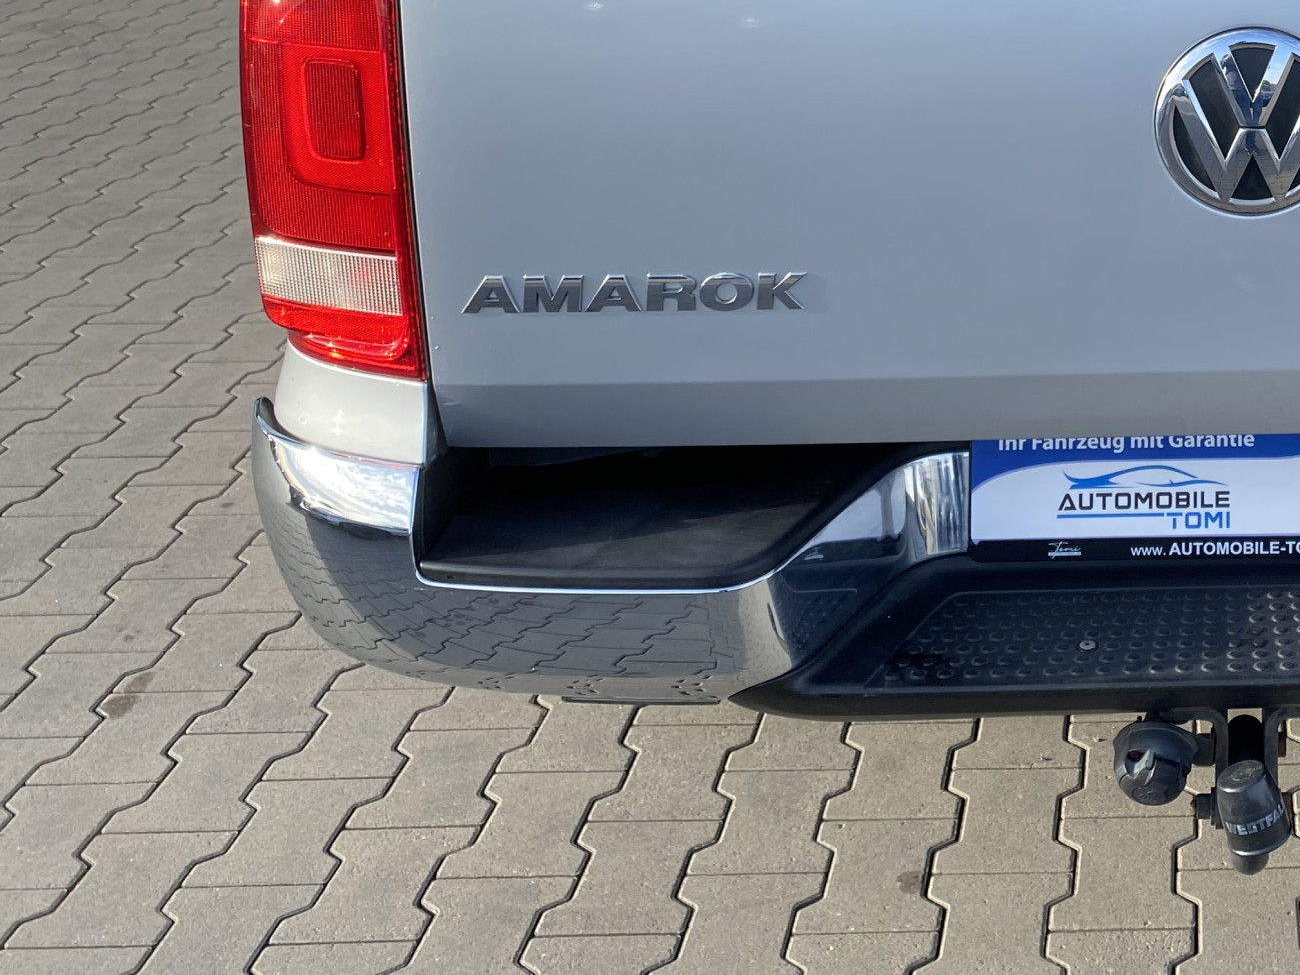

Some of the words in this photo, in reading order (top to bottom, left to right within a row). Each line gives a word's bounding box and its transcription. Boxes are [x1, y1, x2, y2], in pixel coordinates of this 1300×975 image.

[460, 272, 808, 313] AMAROK
[1130, 435, 1164, 450] mit
[1168, 434, 1255, 448] Garantie
[1058, 491, 1230, 511] AUTOMOBILE
[1166, 511, 1230, 530] TOMI
